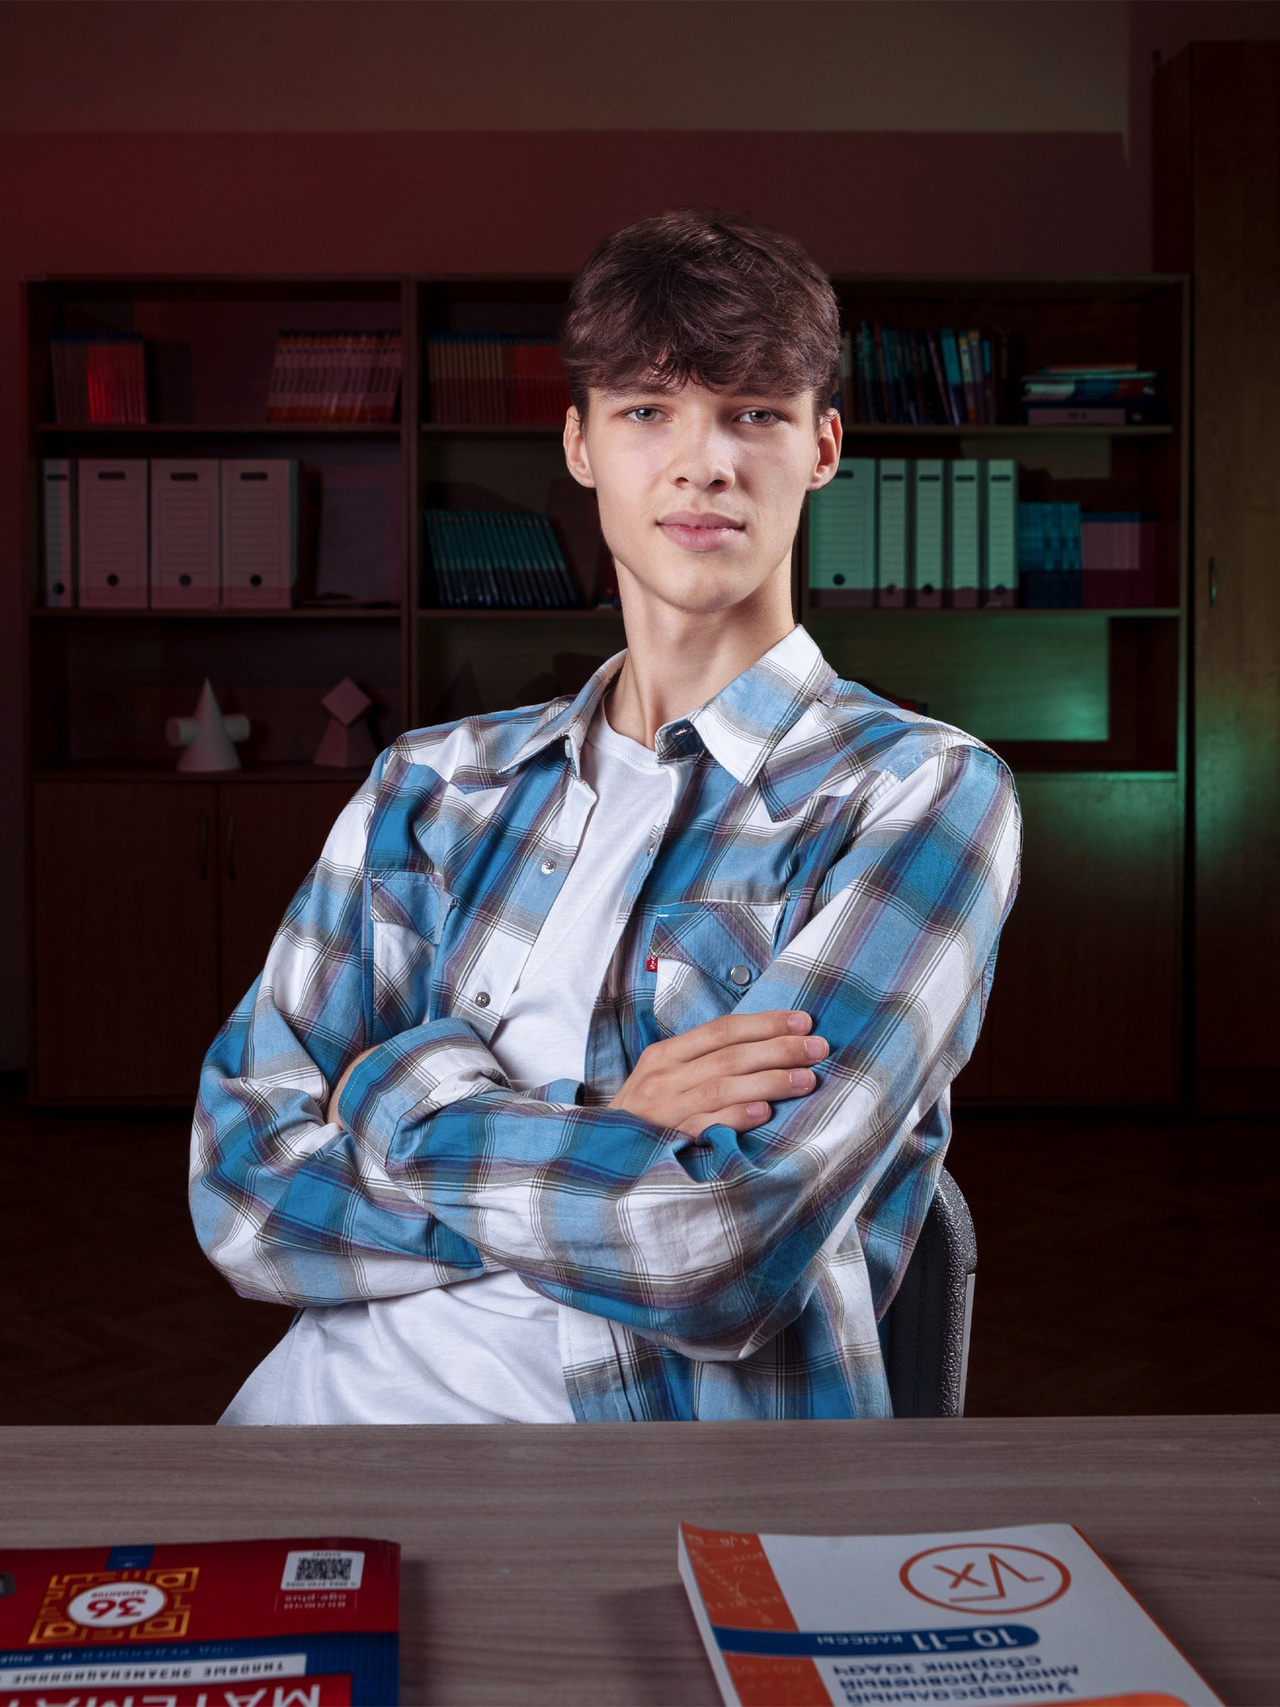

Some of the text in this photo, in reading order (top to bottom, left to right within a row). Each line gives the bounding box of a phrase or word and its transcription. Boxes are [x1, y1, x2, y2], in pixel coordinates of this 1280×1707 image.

[87, 1597, 147, 1620] 36
[11, 1667, 192, 1686] ЭКЗАМЕНАЦИОННЫЕ
[202, 1662, 285, 1678] ТИПОВЫЕ
